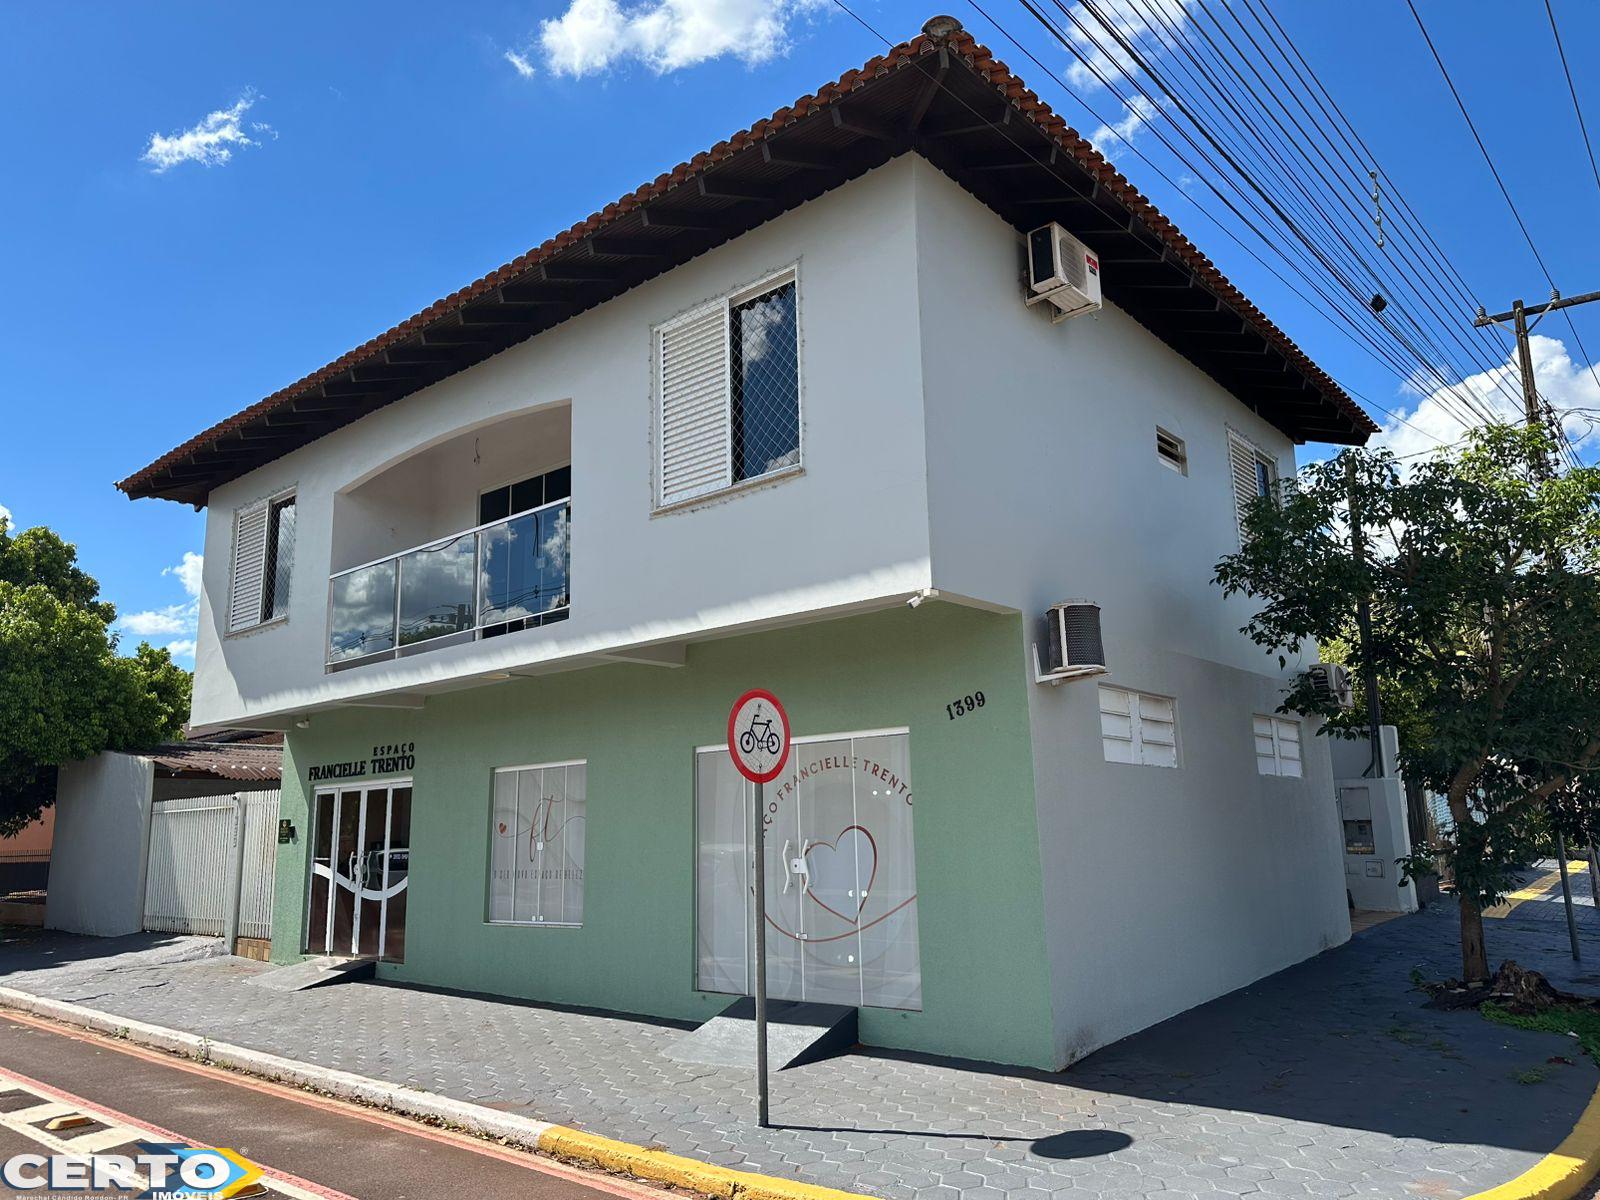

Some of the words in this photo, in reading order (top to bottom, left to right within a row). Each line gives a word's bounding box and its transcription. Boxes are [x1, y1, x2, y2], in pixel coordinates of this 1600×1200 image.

[946, 691, 985, 720] 1399
[373, 742, 415, 757] ESPAÇO
[308, 760, 367, 782] FRANCIELLE
[370, 755, 415, 774] TRENTO
[776, 756, 858, 801] FRANCIELLE
